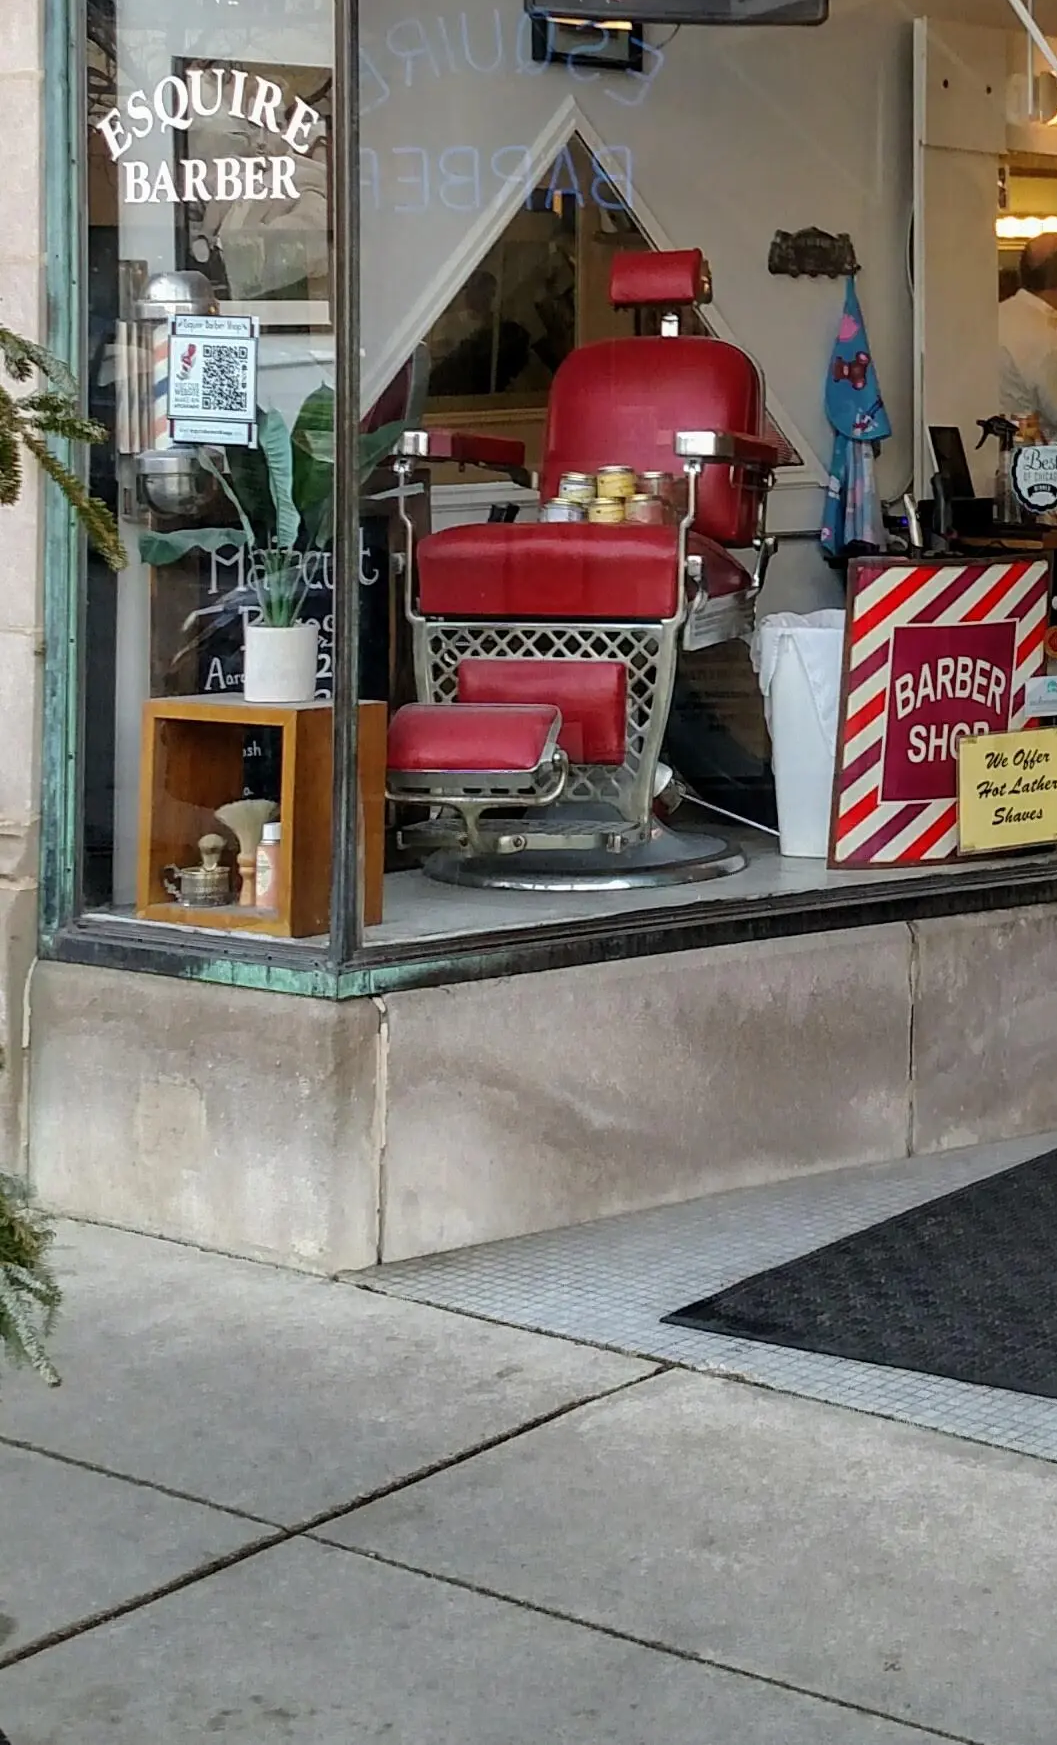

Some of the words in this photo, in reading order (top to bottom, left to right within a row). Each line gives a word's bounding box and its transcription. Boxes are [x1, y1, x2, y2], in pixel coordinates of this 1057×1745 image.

[96, 68, 320, 162] ESQUIRE
[123, 156, 300, 204] BARBER
[895, 656, 1006, 720] BARBER
[985, 751, 1009, 769] We
[1013, 748, 1051, 771] Offer
[976, 780, 1006, 800] Hot
[991, 806, 1044, 826] Shaves
